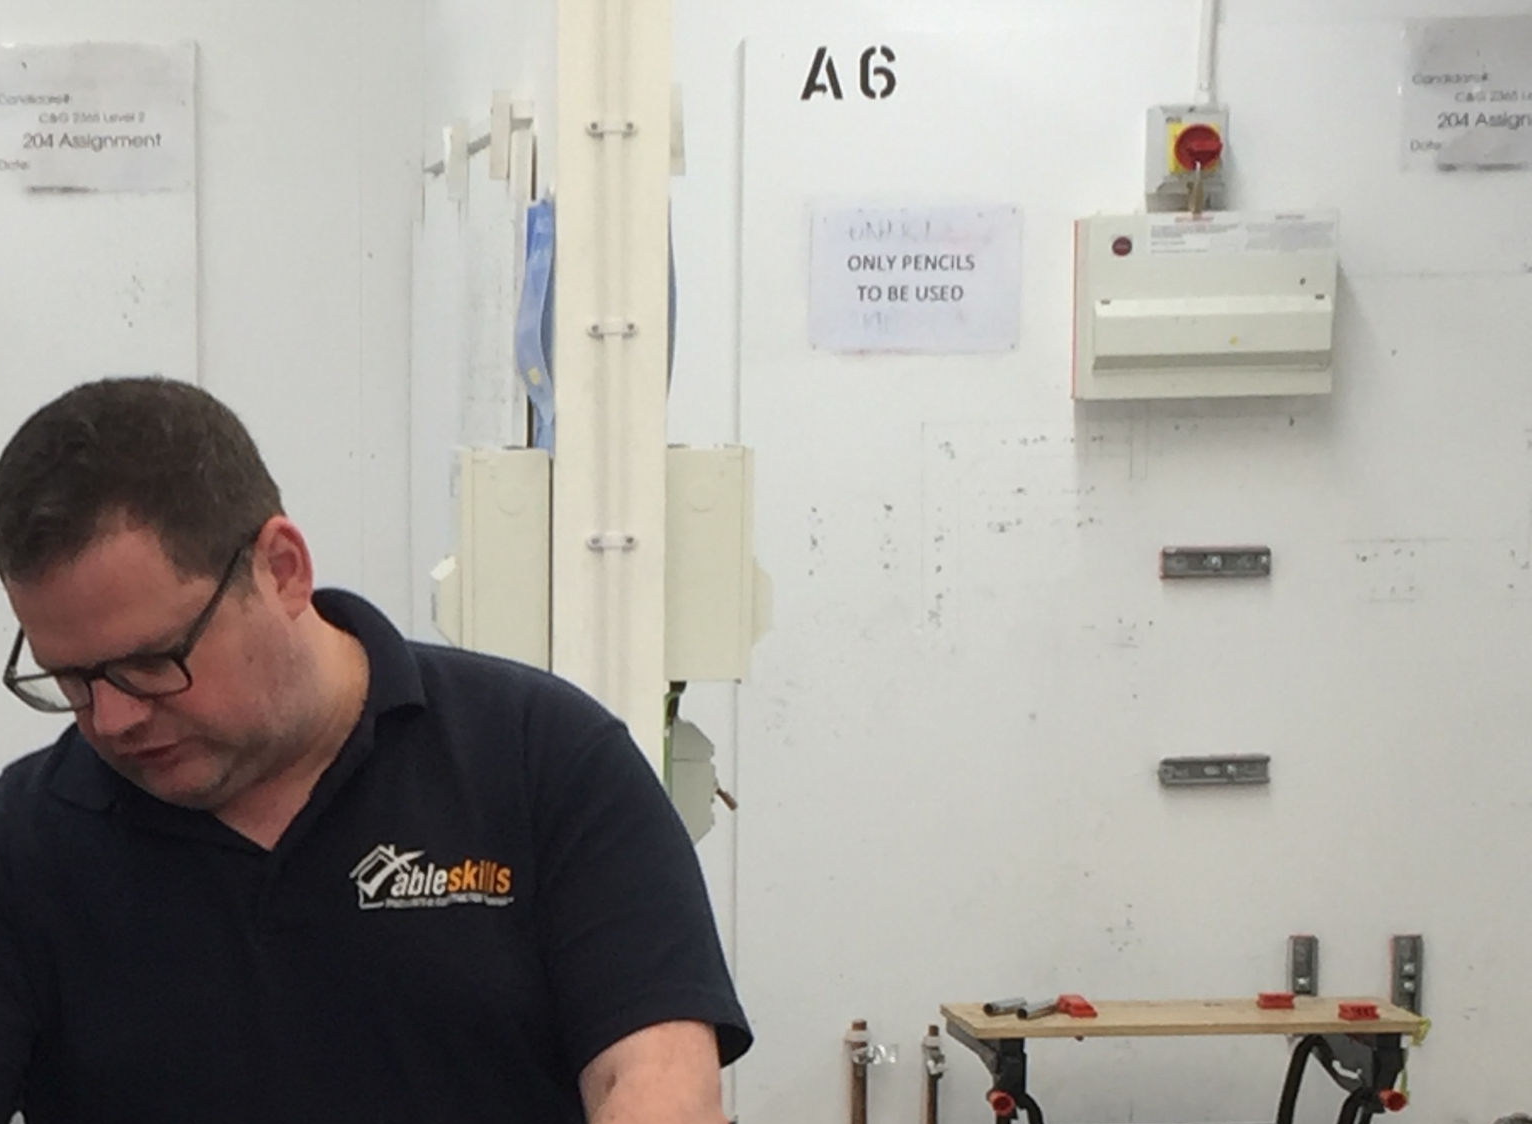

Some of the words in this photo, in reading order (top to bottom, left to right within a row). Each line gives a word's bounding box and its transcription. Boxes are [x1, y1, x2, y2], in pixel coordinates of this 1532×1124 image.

[1438, 112, 1469, 129] 204
[23, 133, 54, 150] 204
[58, 132, 163, 153] Assignment
[847, 254, 897, 272] ONLY
[901, 254, 976, 272] PENCILS
[857, 285, 882, 302] TO
[887, 285, 910, 302] BE
[915, 285, 964, 302] USED
